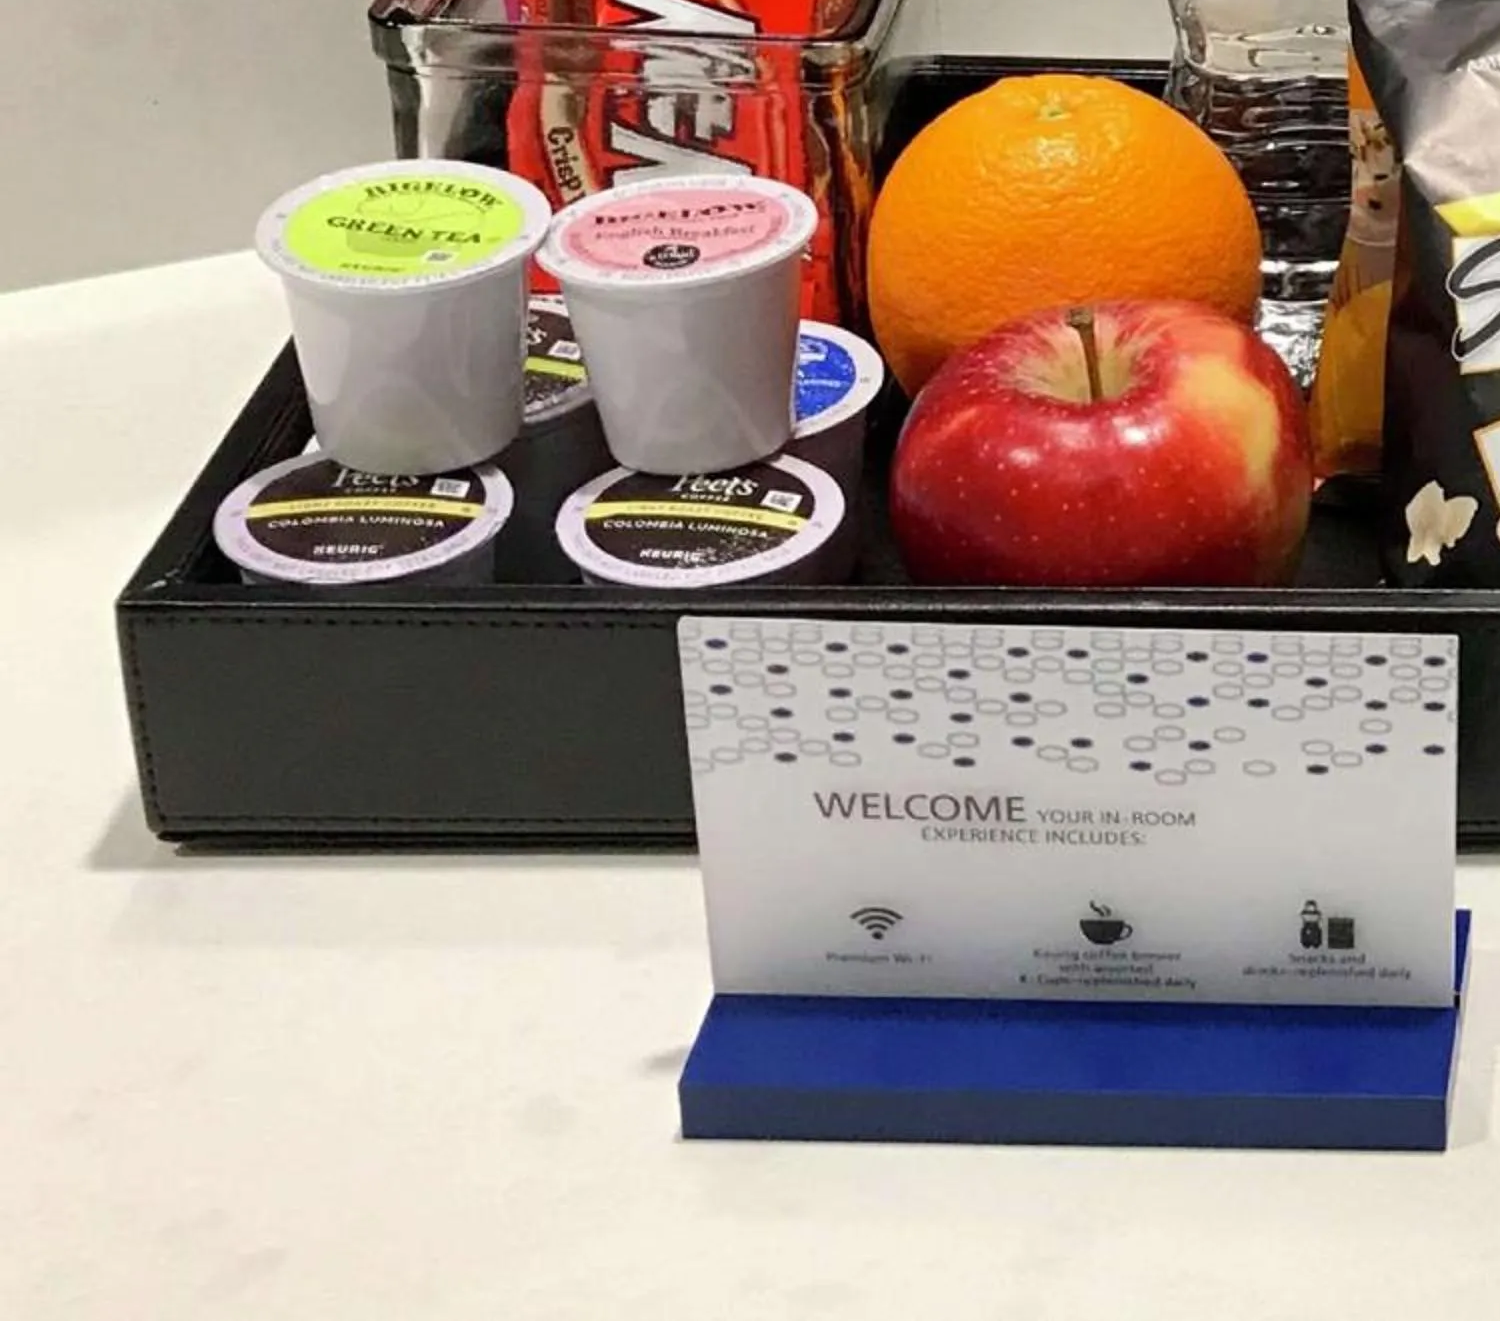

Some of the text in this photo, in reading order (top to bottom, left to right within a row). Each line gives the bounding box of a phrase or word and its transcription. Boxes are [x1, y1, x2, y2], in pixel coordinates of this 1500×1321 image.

[326, 215, 482, 244] GREEN TEA
[267, 515, 445, 528] COLOMBIA LUMINOSA
[602, 519, 768, 538] COLOMBIA LUMINOSA
[312, 544, 380, 556] KEURIG
[639, 548, 701, 563] KEURIG
[813, 791, 1027, 823] WELCOME
[1036, 809, 1094, 825] YOUR
[921, 826, 1147, 846] EXPERIENCE INCLUDES:
